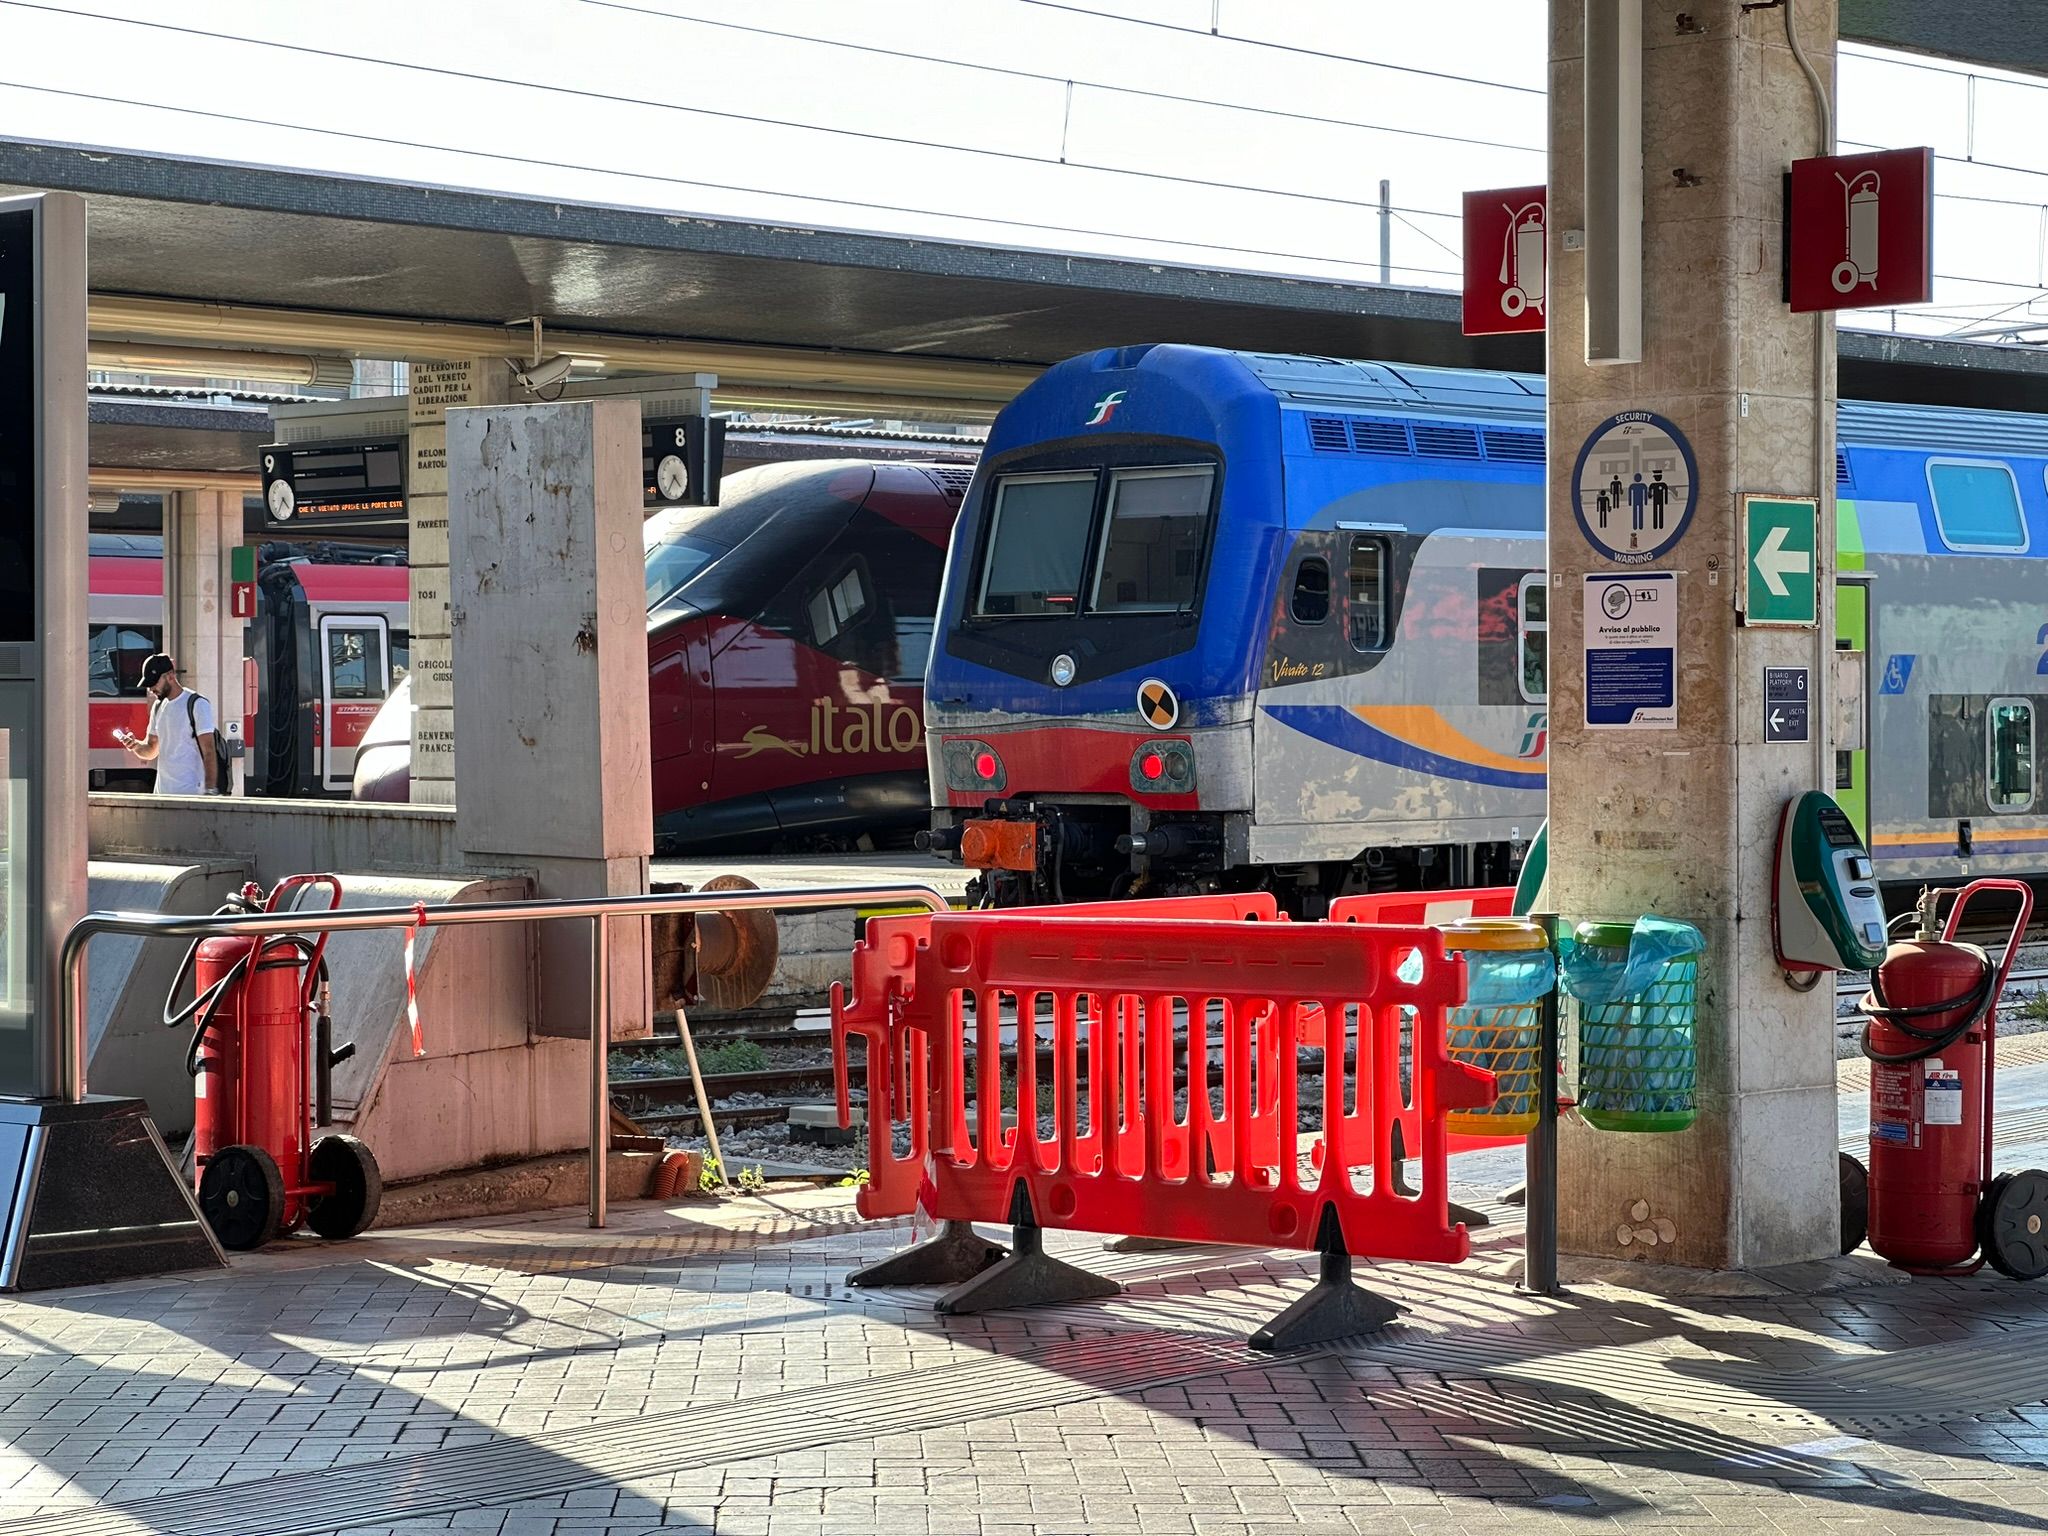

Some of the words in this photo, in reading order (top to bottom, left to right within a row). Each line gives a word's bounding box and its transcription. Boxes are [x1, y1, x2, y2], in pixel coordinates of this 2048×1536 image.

[426, 361, 471, 373] FERROVIERI
[418, 375, 433, 384] DEL
[437, 372, 467, 382] VENETO
[413, 385, 441, 395] CADUTI
[445, 384, 459, 393] PER
[461, 383, 472, 392] LA
[418, 394, 468, 405] LIBERAZIONE
[1615, 412, 1653, 424] SECURITY
[675, 427, 686, 447] 8
[418, 448, 447, 458] MELONI
[264, 454, 275, 473] 9
[418, 459, 448, 469] BARTOL
[1614, 552, 1653, 565] WARNING
[418, 591, 437, 600] TOSI
[1631, 625, 1661, 633] pubblico
[1271, 656, 1309, 682] Vivalto
[1311, 663, 1325, 676] 12
[1797, 675, 1804, 690] 6
